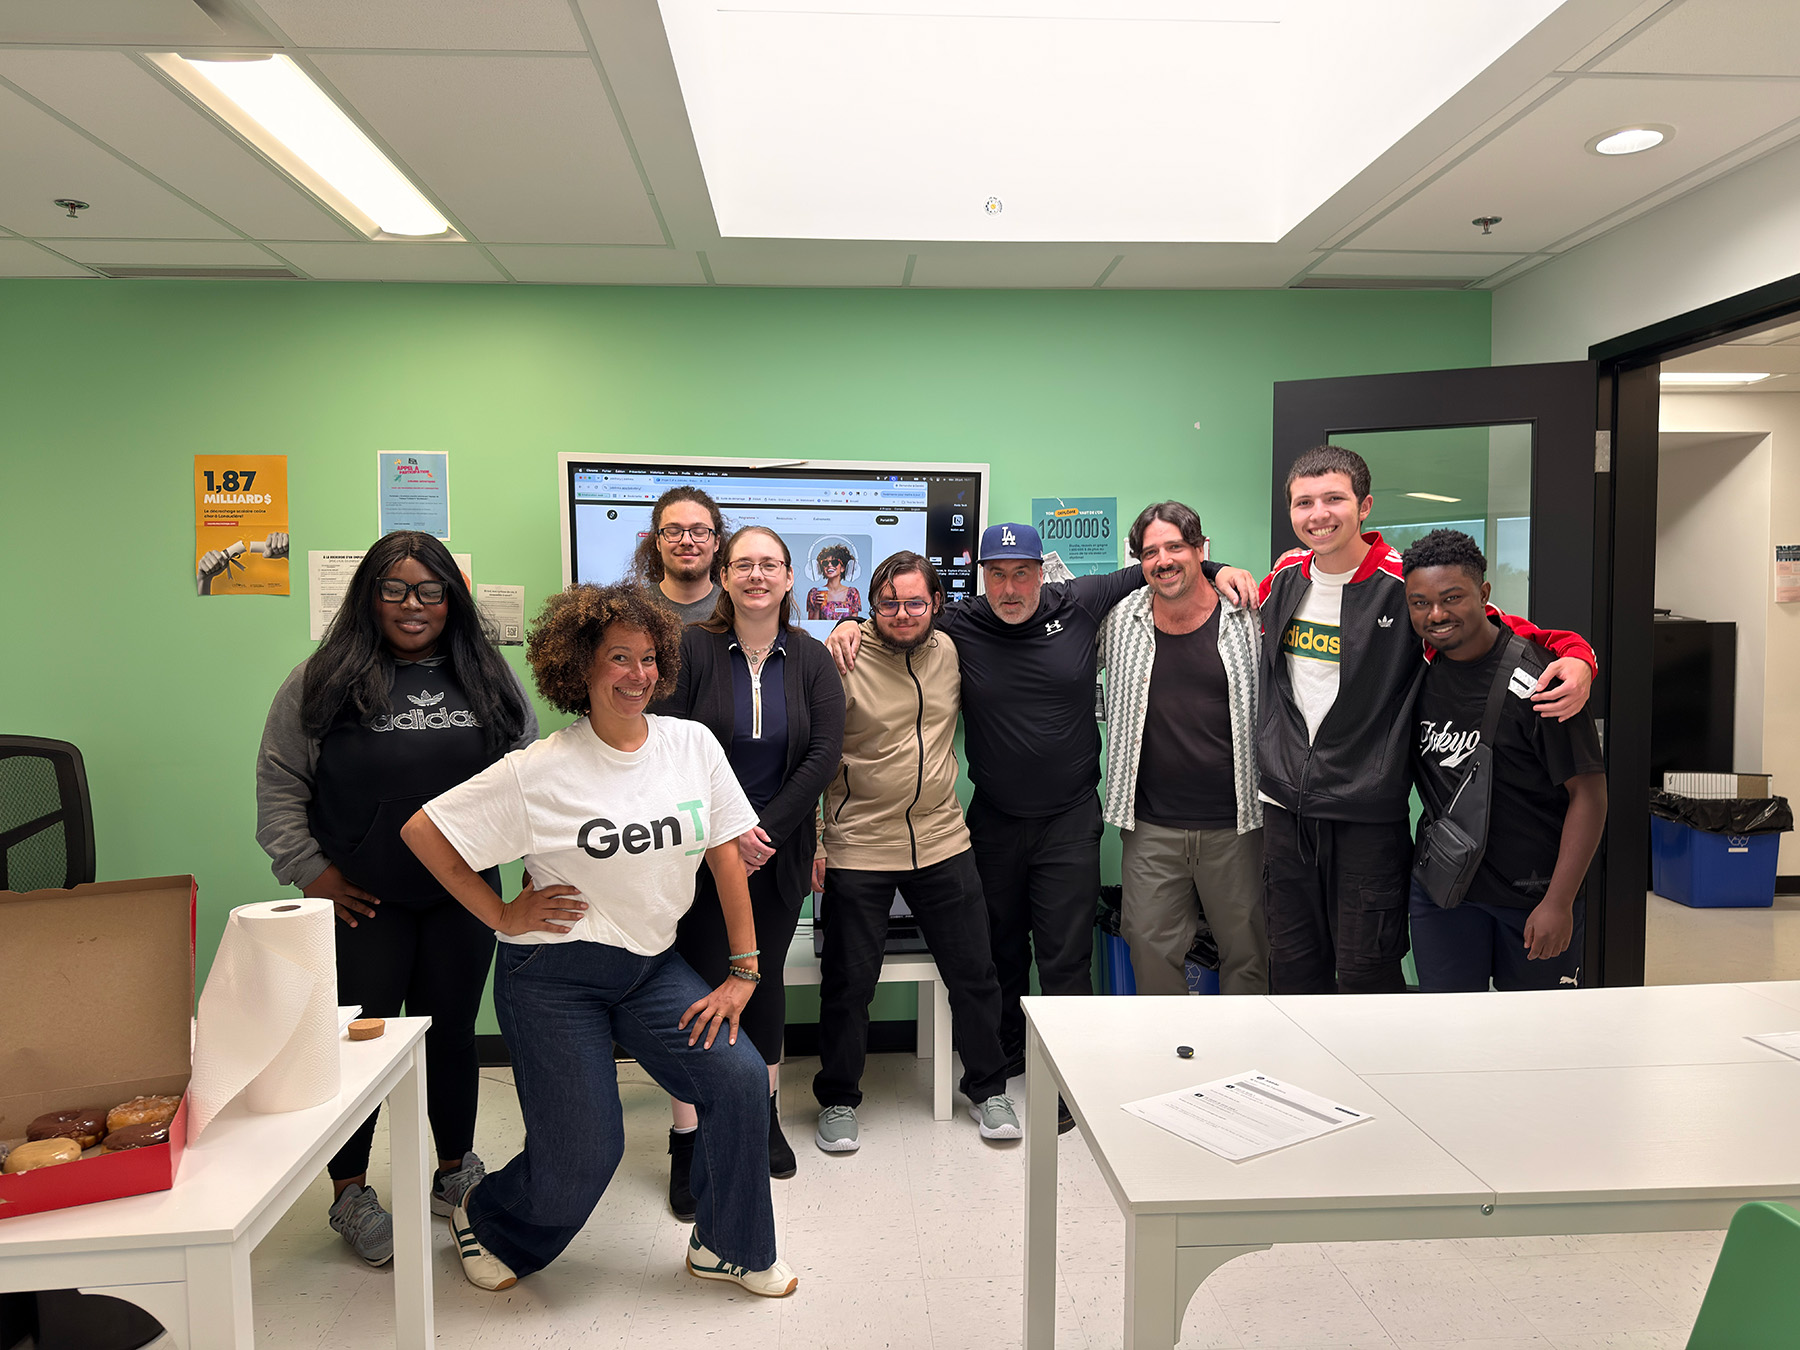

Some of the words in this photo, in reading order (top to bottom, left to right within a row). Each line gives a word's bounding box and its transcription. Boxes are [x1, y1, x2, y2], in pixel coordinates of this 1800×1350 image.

[204, 470, 257, 493] 1,87
[1001, 526, 1016, 545] LA
[1283, 625, 1340, 655] didas
